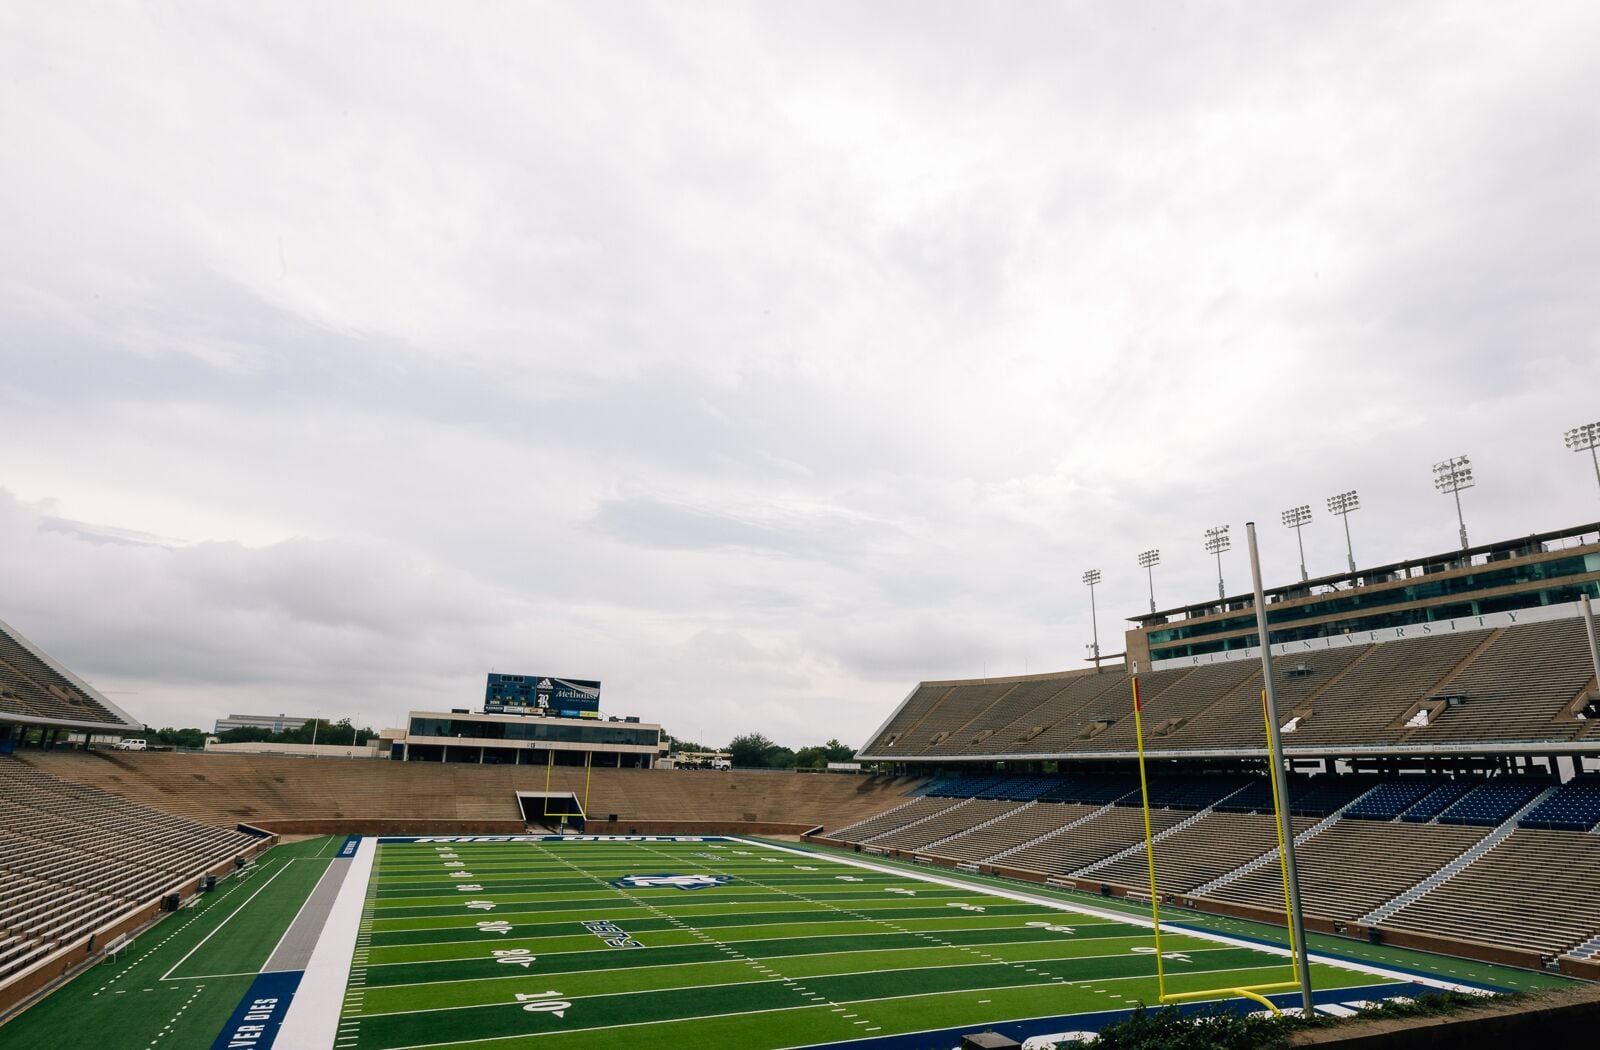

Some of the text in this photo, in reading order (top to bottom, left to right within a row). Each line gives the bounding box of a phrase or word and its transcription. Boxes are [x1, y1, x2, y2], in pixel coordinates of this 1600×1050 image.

[1192, 611, 1519, 665] RICE UNIVERSITY
[491, 948, 536, 964] 20
[515, 991, 572, 1012] 10
[228, 998, 278, 1050] VER DIES
